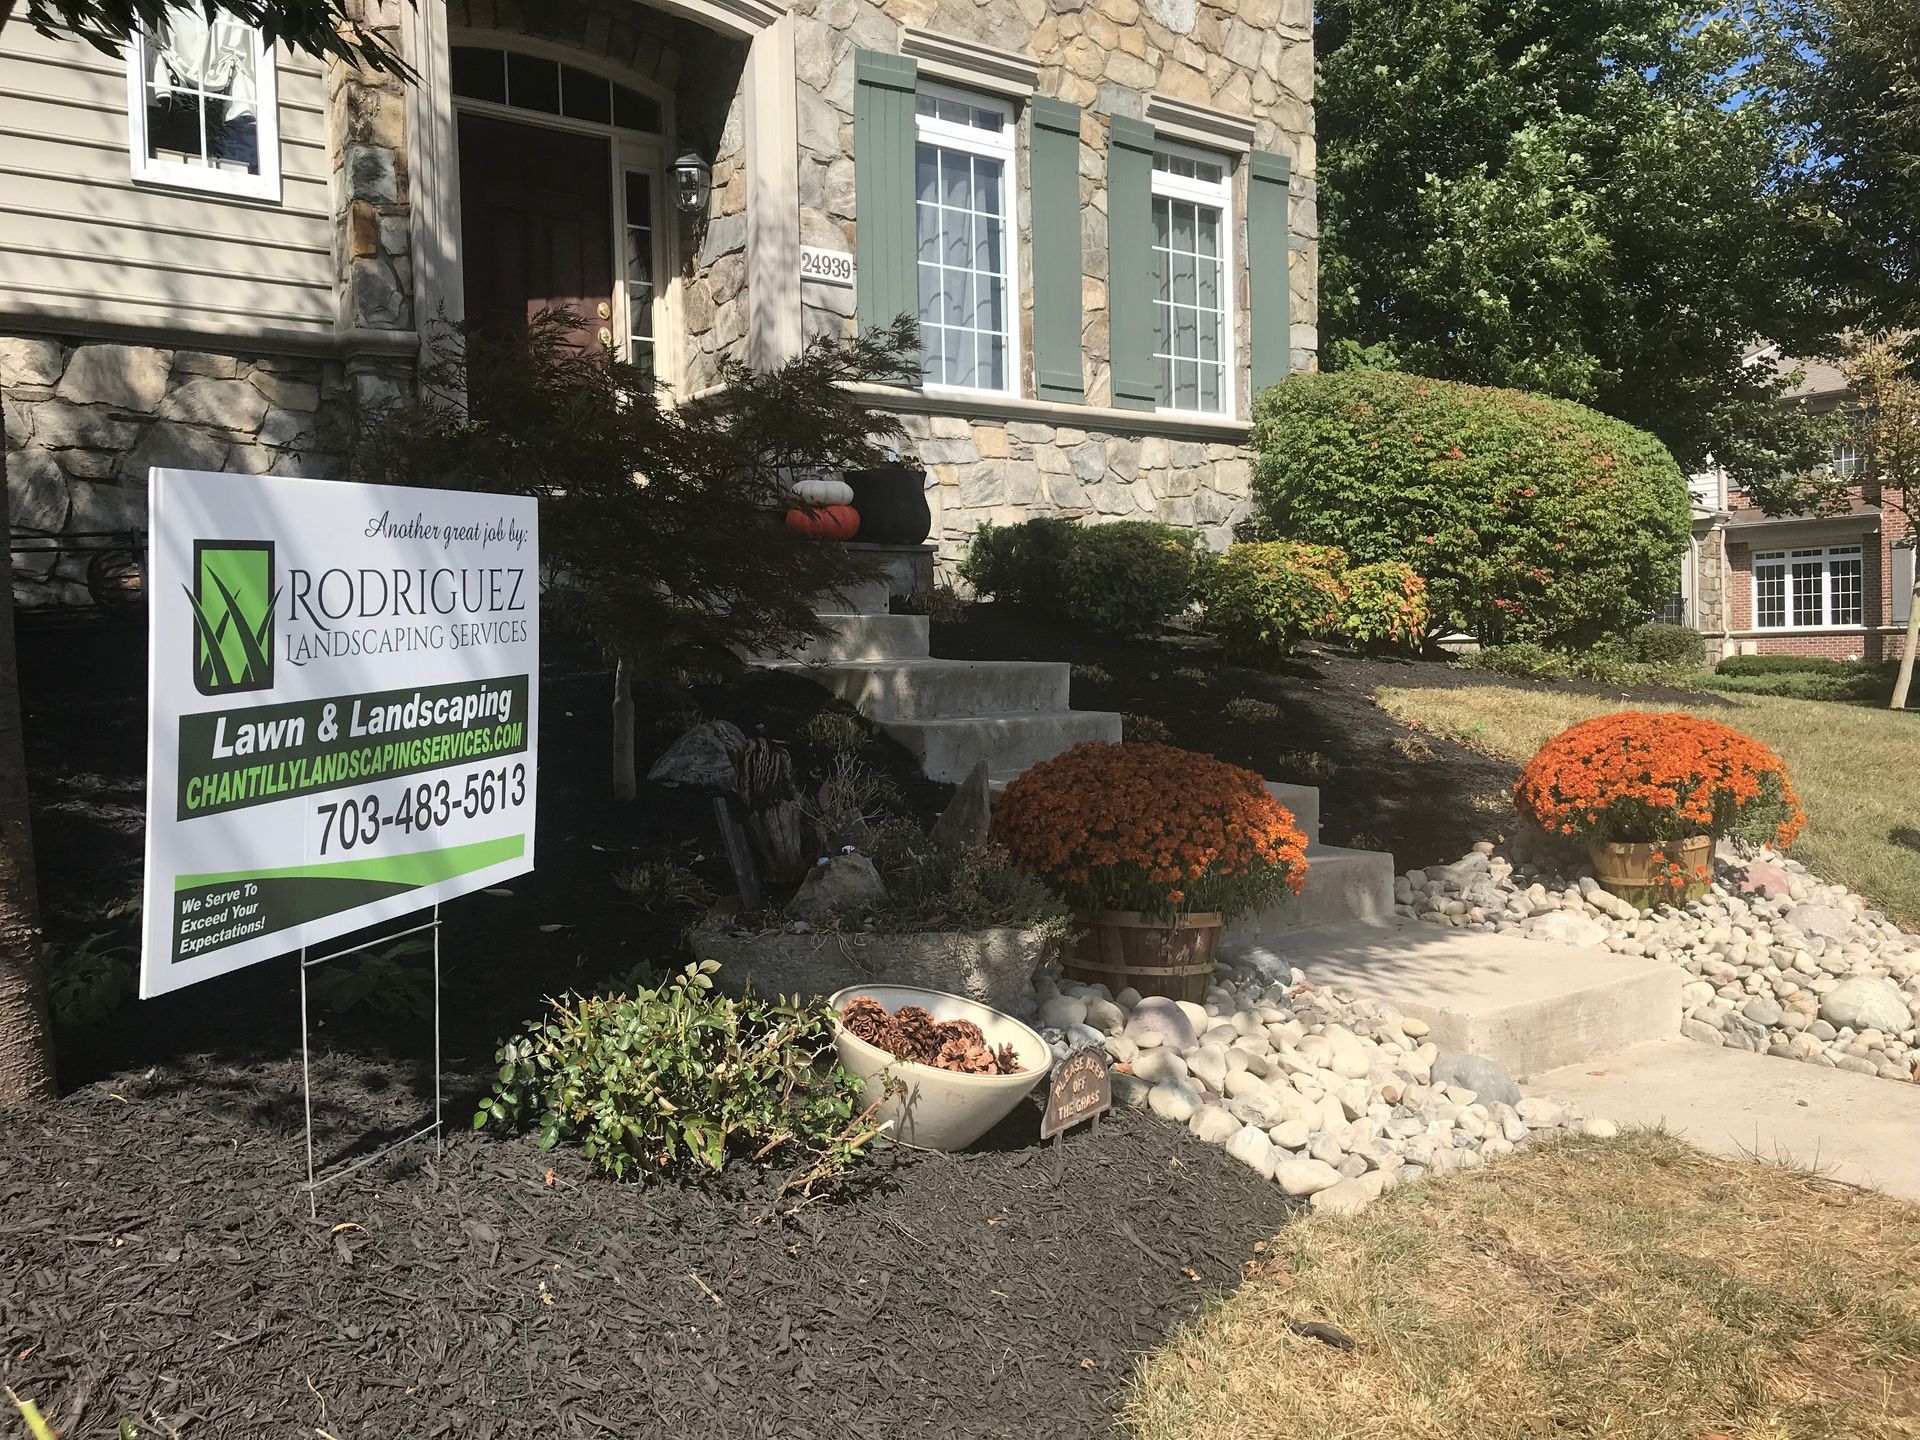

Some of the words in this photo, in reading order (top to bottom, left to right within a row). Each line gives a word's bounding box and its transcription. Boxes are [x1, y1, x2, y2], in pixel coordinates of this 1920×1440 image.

[802, 252, 851, 279] 24939
[365, 510, 440, 541] Another
[442, 522, 481, 549] great
[483, 517, 505, 550] job
[508, 516, 528, 551] by:
[288, 568, 526, 631] RODRIGUEZ
[286, 624, 444, 666] LANDSCAPING
[450, 619, 527, 650] SERVICES
[212, 714, 305, 758] Lawn
[318, 702, 337, 742] &
[349, 686, 513, 739] Landscaping
[187, 722, 522, 811] CHANTILLYLANDSCAPINGSERVICES.COM
[317, 763, 526, 856] 703-483-5613
[181, 909, 229, 935] Exceed
[232, 902, 259, 919] Your
[182, 898, 202, 914] We
[205, 889, 241, 908] Serve
[244, 883, 258, 896] To
[179, 916, 266, 954] Expectations!
[1055, 1057, 1084, 1099] PLEASE
[1073, 1078, 1086, 1093] OFF
[1058, 1102, 1074, 1120] THE
[1076, 1090, 1100, 1112] GRASS
